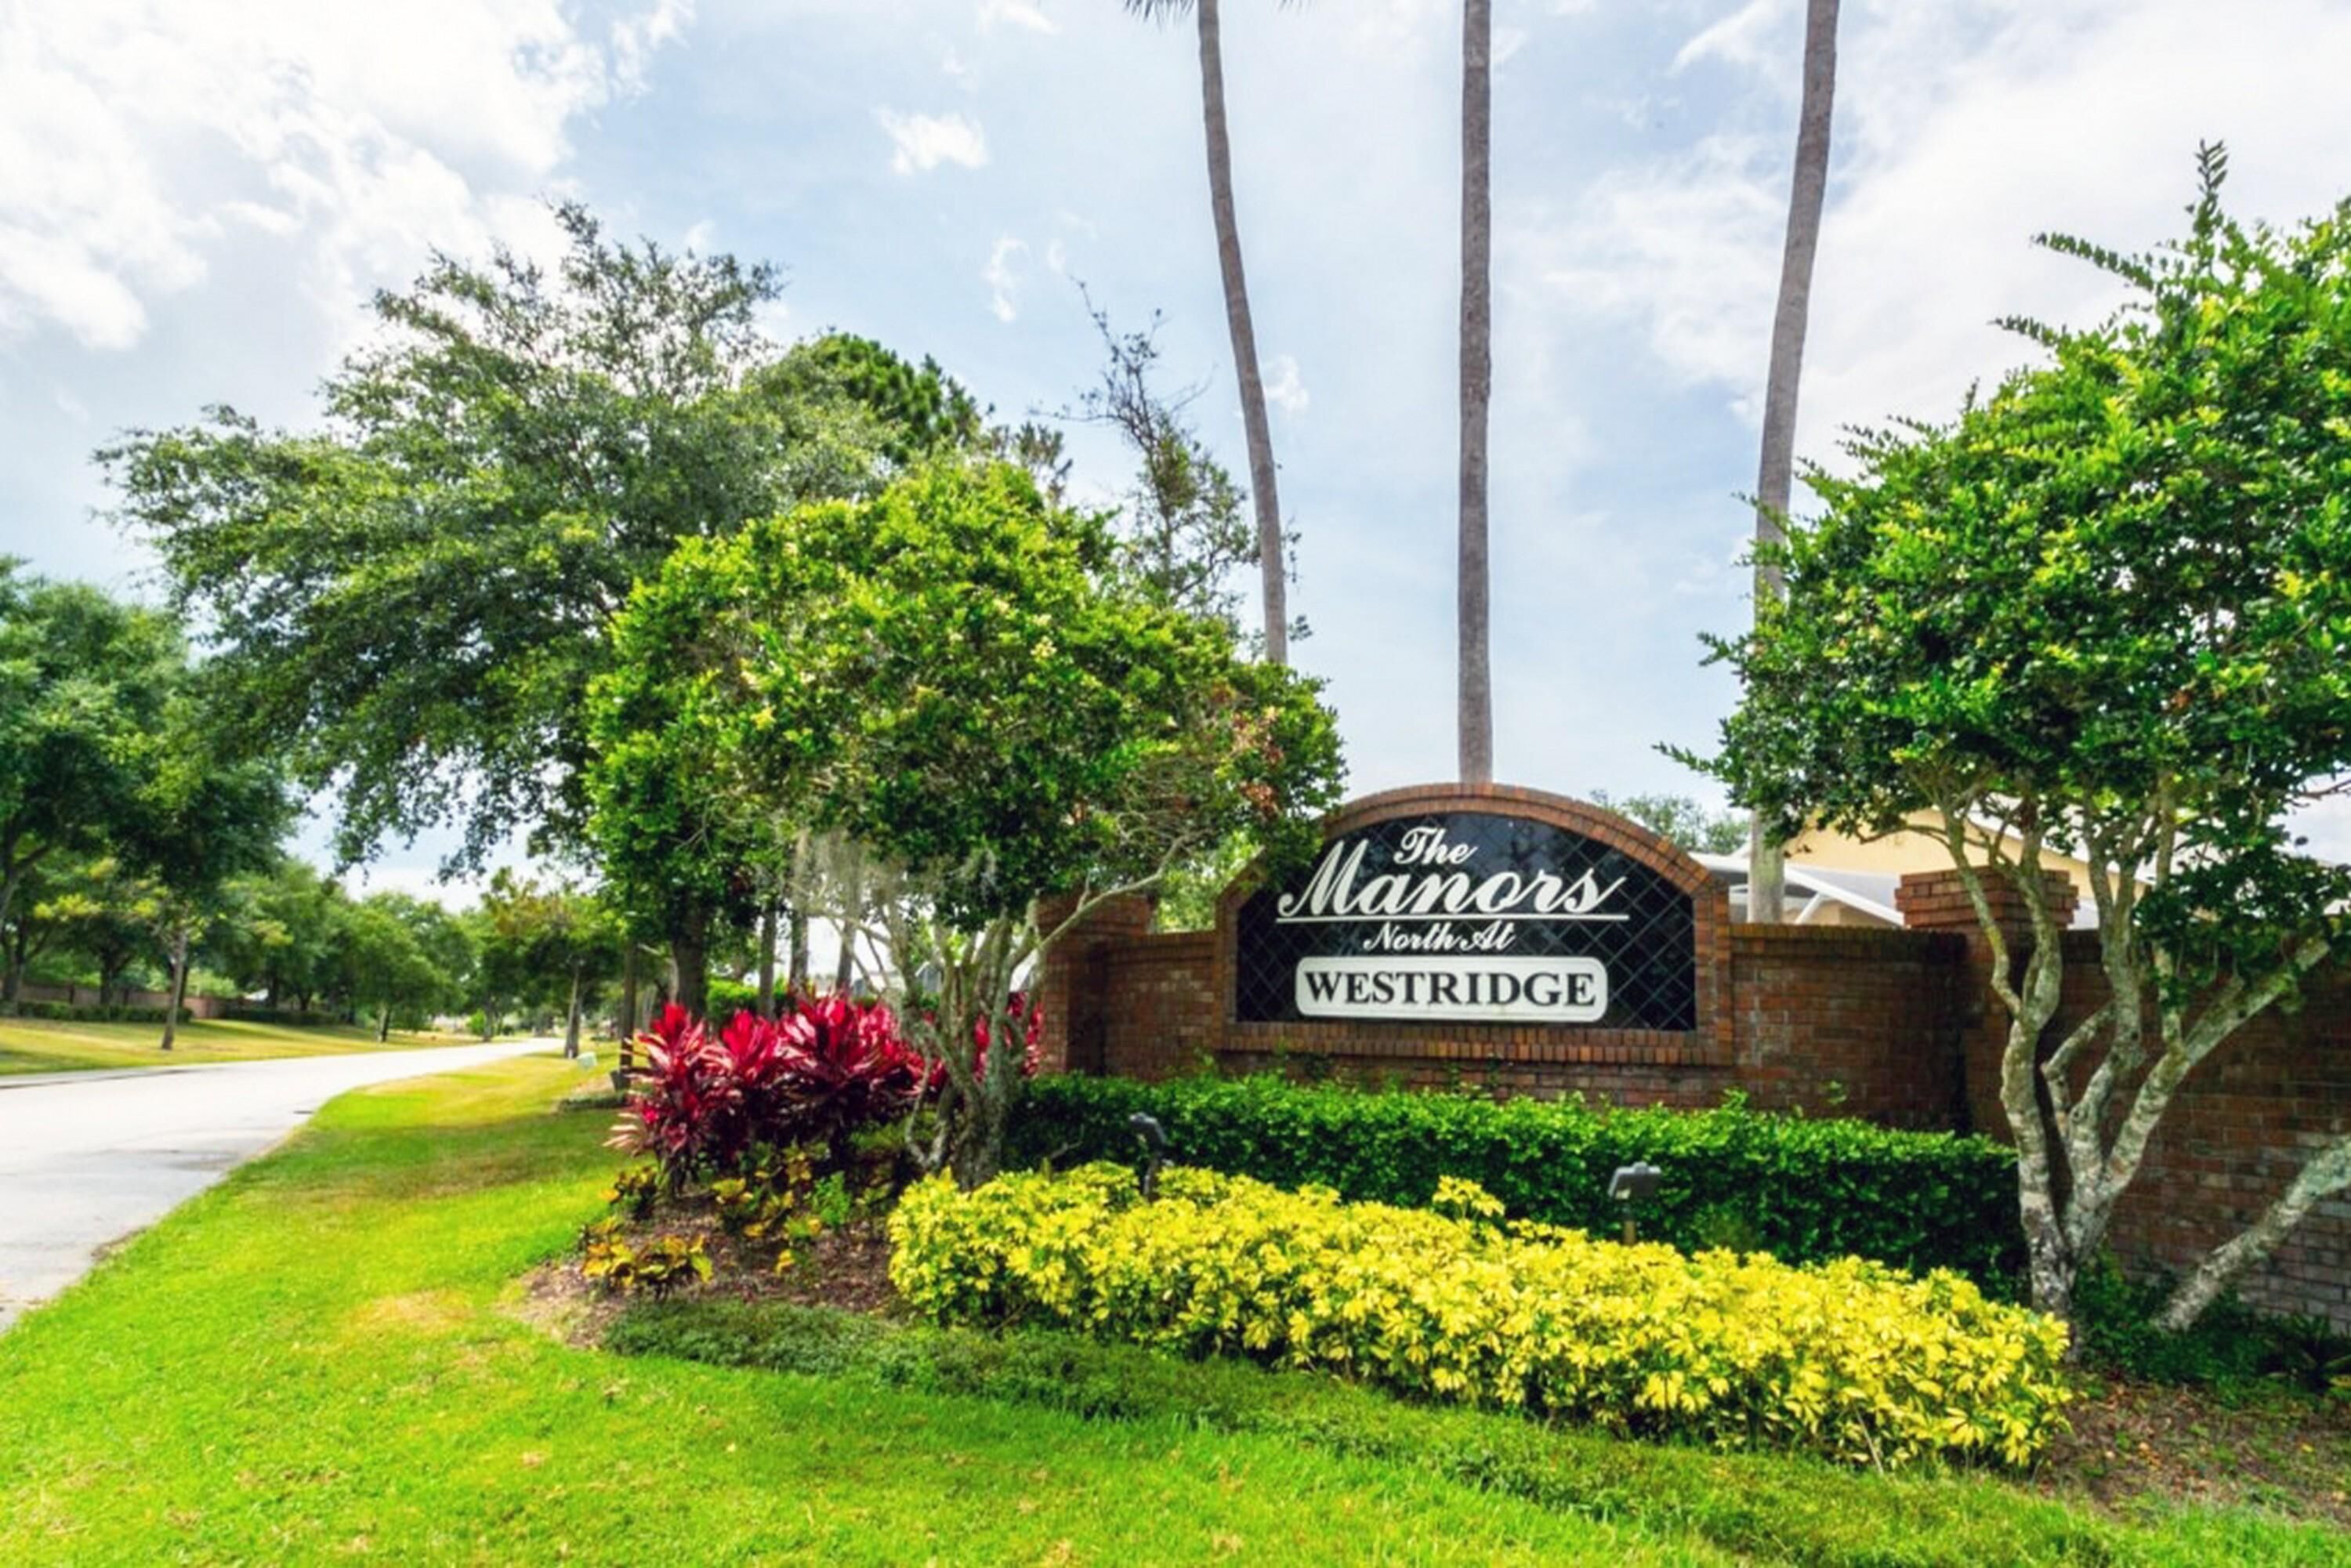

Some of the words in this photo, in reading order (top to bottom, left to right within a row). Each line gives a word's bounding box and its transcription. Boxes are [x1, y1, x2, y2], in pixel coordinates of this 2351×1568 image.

[1393, 827, 1476, 864] The
[1277, 839, 1627, 916] Manors
[1364, 921, 1462, 951] North
[1459, 920, 1516, 951] At
[1303, 971, 1596, 1007] WESTRIDGE
